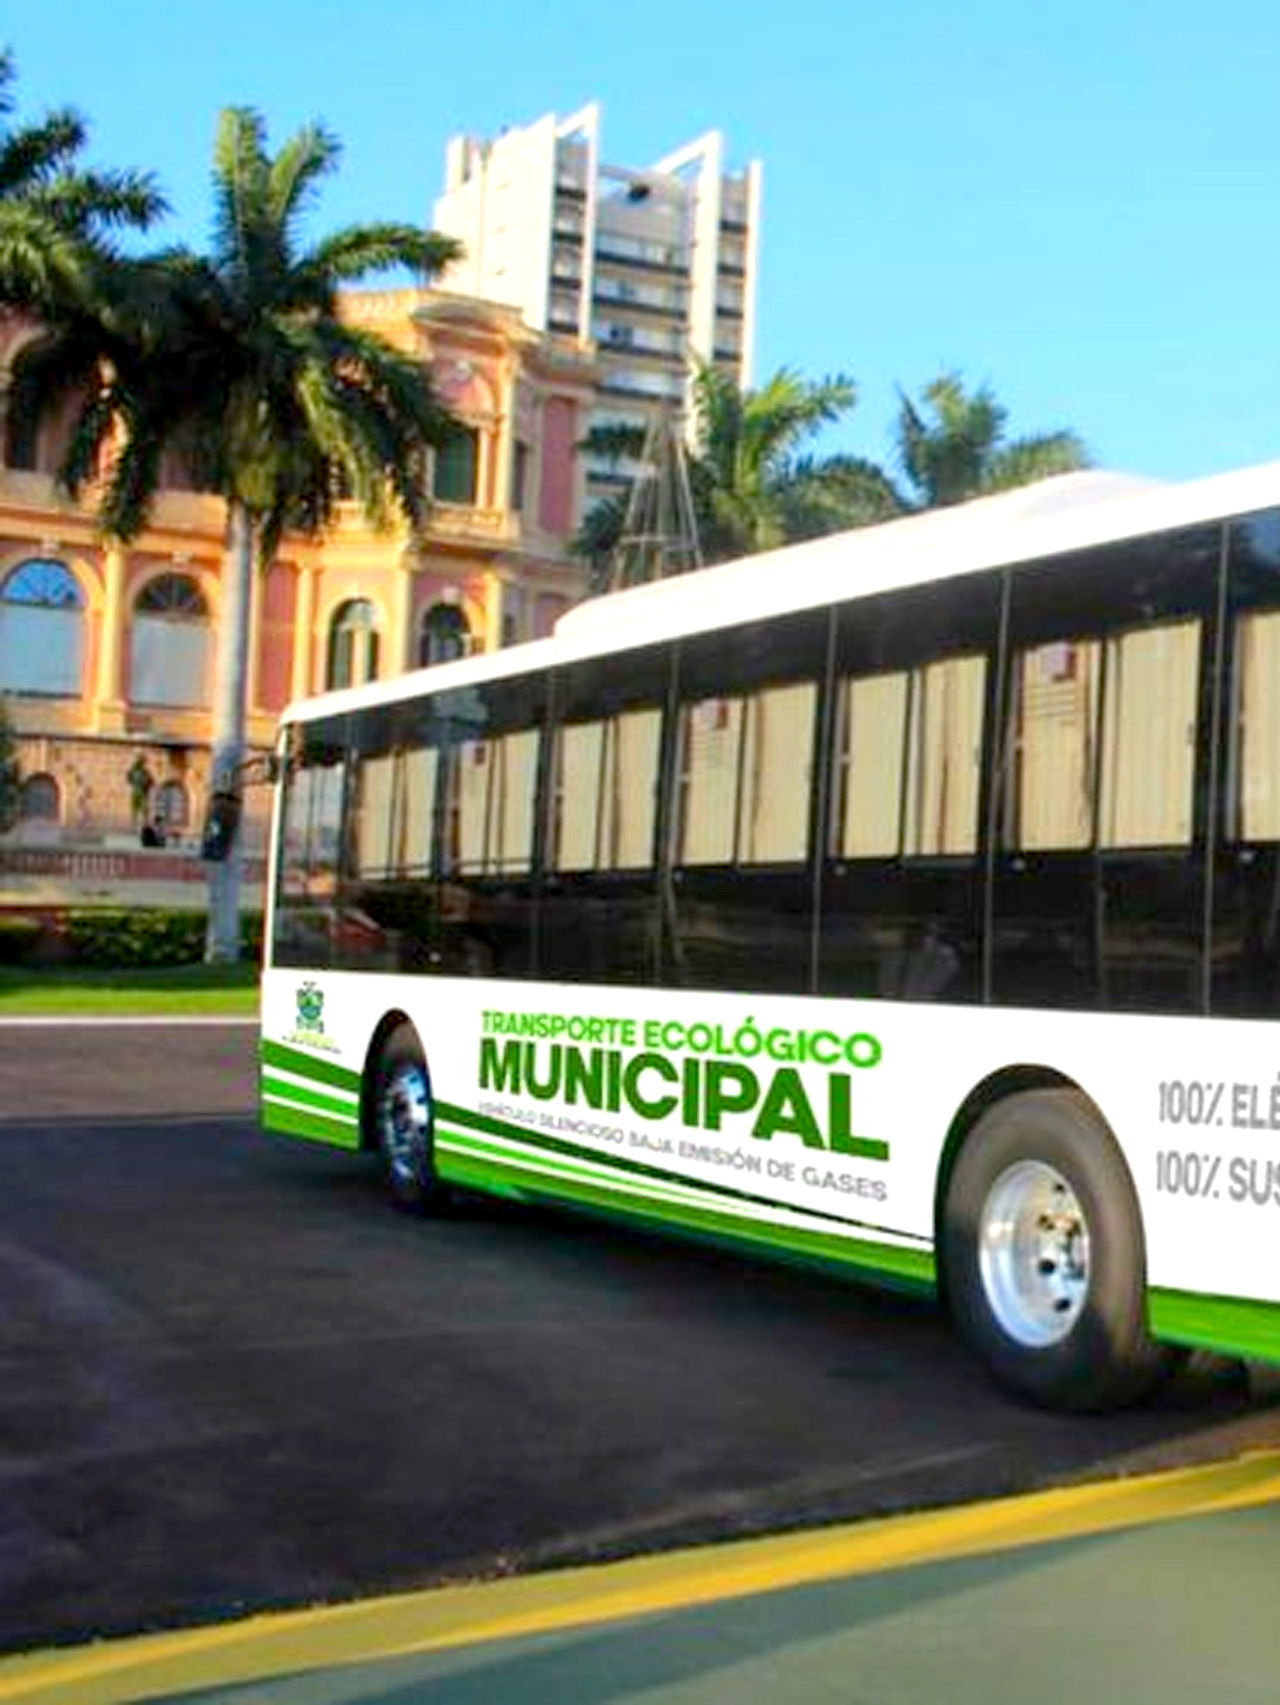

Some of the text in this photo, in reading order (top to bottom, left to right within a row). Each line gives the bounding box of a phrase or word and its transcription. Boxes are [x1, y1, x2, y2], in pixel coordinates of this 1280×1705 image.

[481, 1010, 882, 1069] TRANSPORTE ECOLÓGICO
[479, 1037, 890, 1162] MUNICIPAL
[1158, 1080, 1225, 1126] 100%
[629, 1130, 675, 1154] BAJA
[678, 1139, 762, 1175] EMISIÓN
[766, 1158, 795, 1182] DE
[801, 1166, 887, 1202] GASES
[1156, 1150, 1221, 1199] 100%
